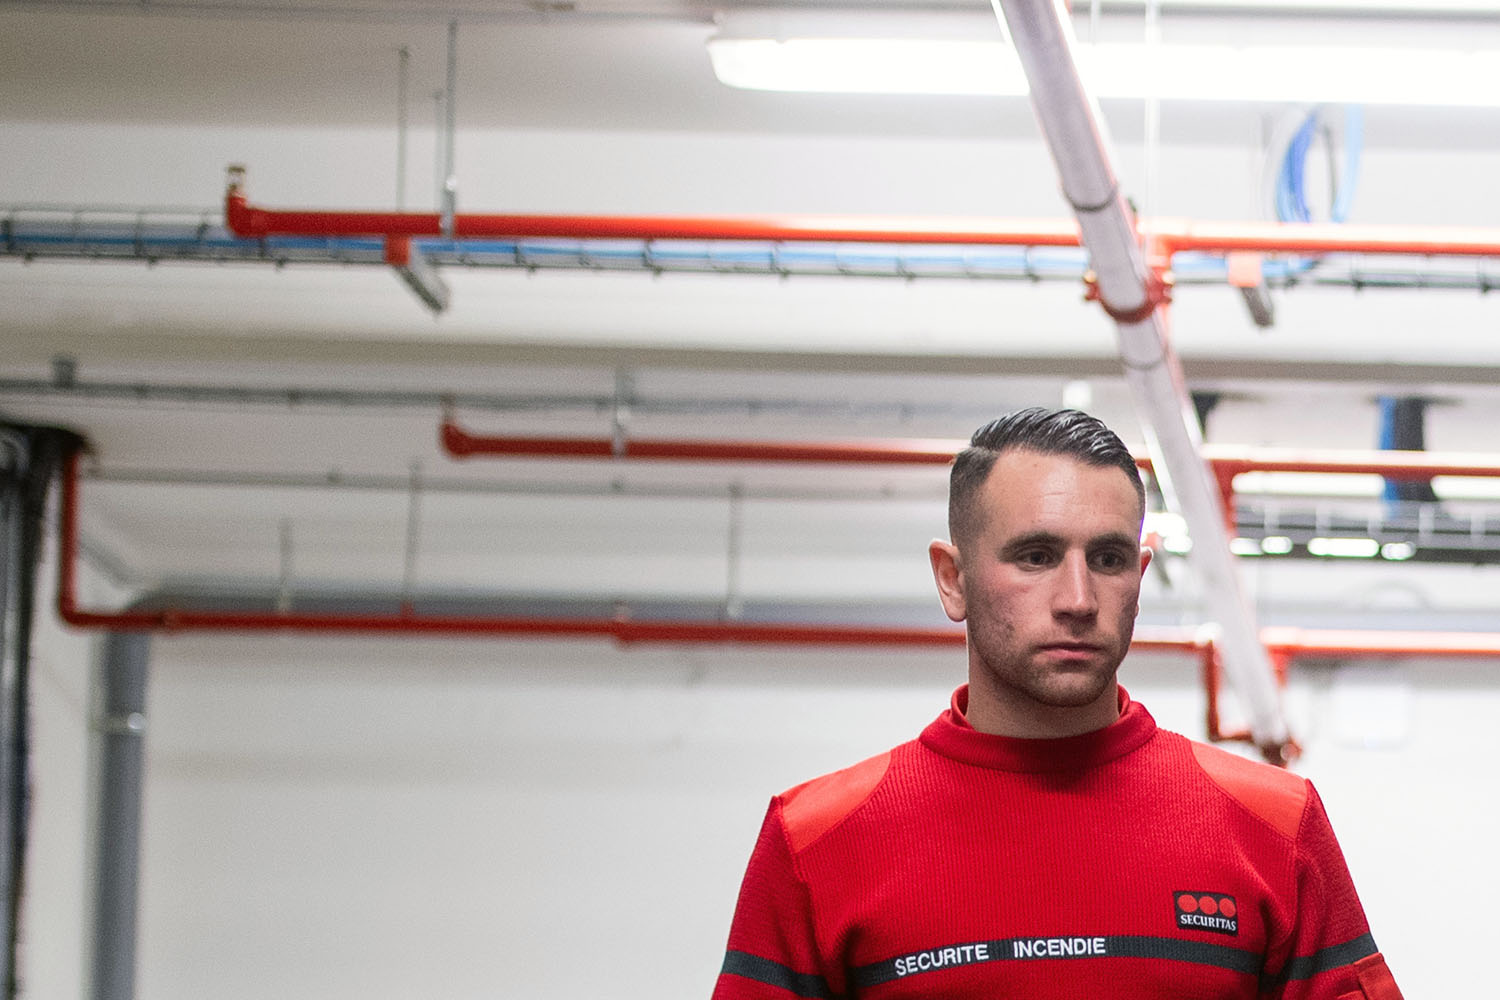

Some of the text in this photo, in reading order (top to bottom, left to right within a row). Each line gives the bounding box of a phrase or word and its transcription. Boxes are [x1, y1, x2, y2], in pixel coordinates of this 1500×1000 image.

[1180, 914, 1237, 931] SECURITAS
[894, 937, 1106, 977] SECURITE INCENDIE
